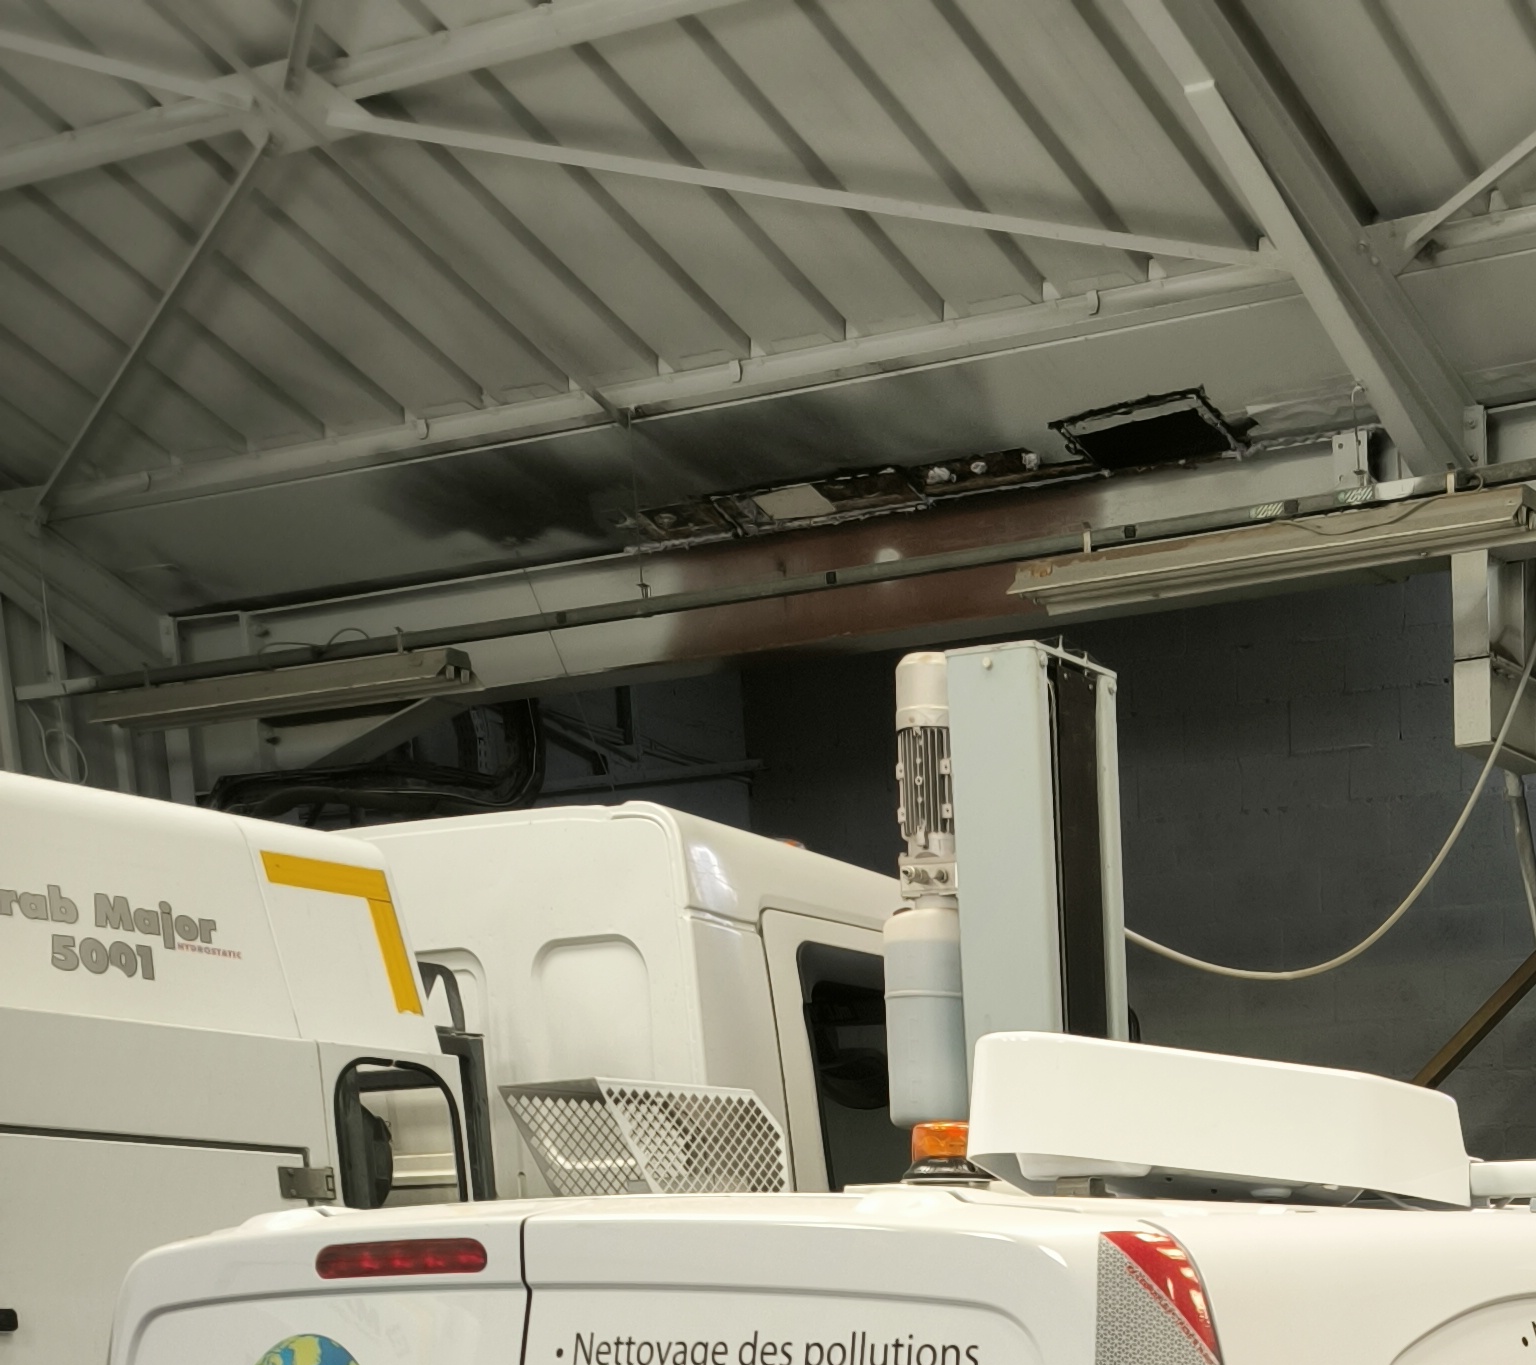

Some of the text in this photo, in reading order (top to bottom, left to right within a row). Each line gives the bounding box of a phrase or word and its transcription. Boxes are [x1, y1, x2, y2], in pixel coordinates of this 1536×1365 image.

[94, 892, 217, 950] Major
[51, 934, 155, 980] 5001
[177, 942, 242, 960] HYDROSTATIC
